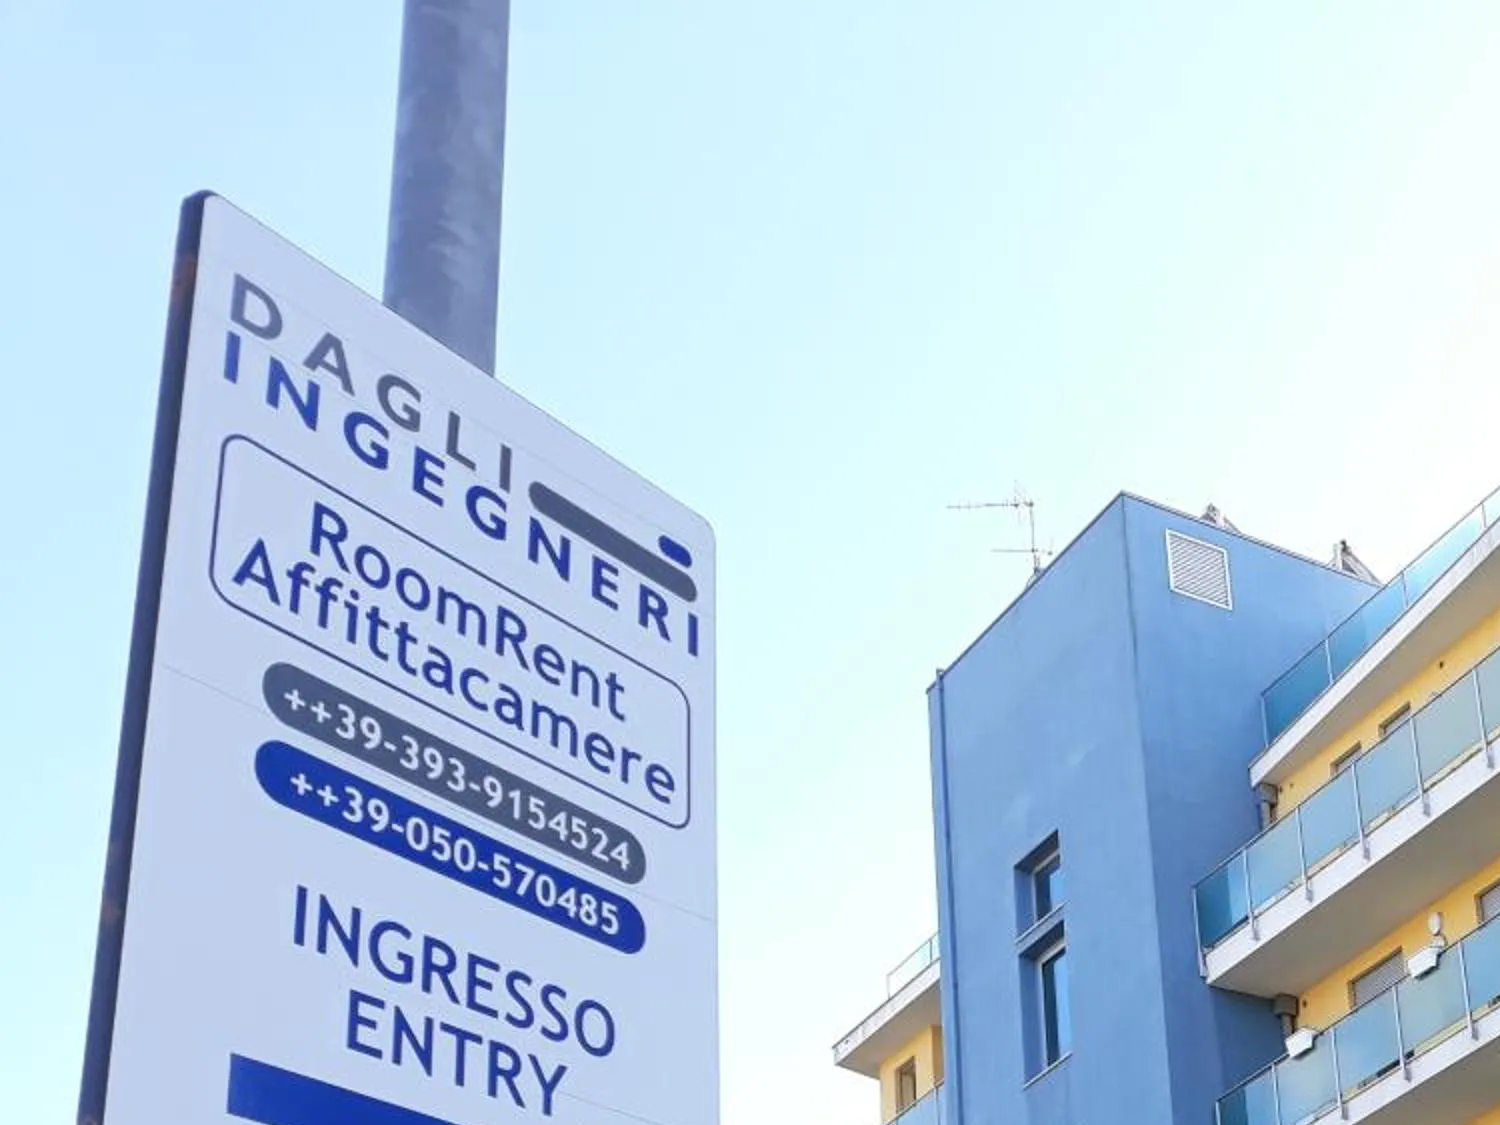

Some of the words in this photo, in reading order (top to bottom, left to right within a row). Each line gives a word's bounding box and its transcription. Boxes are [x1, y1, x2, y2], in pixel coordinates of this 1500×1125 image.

[223, 331, 699, 657] INGEGNERI
[230, 273, 513, 494] DAGLI
[232, 538, 676, 805] Affittacamere
[309, 501, 627, 722] RoomRent
[293, 884, 616, 1058] INGRESSO
[346, 989, 568, 1117] ENTRY
